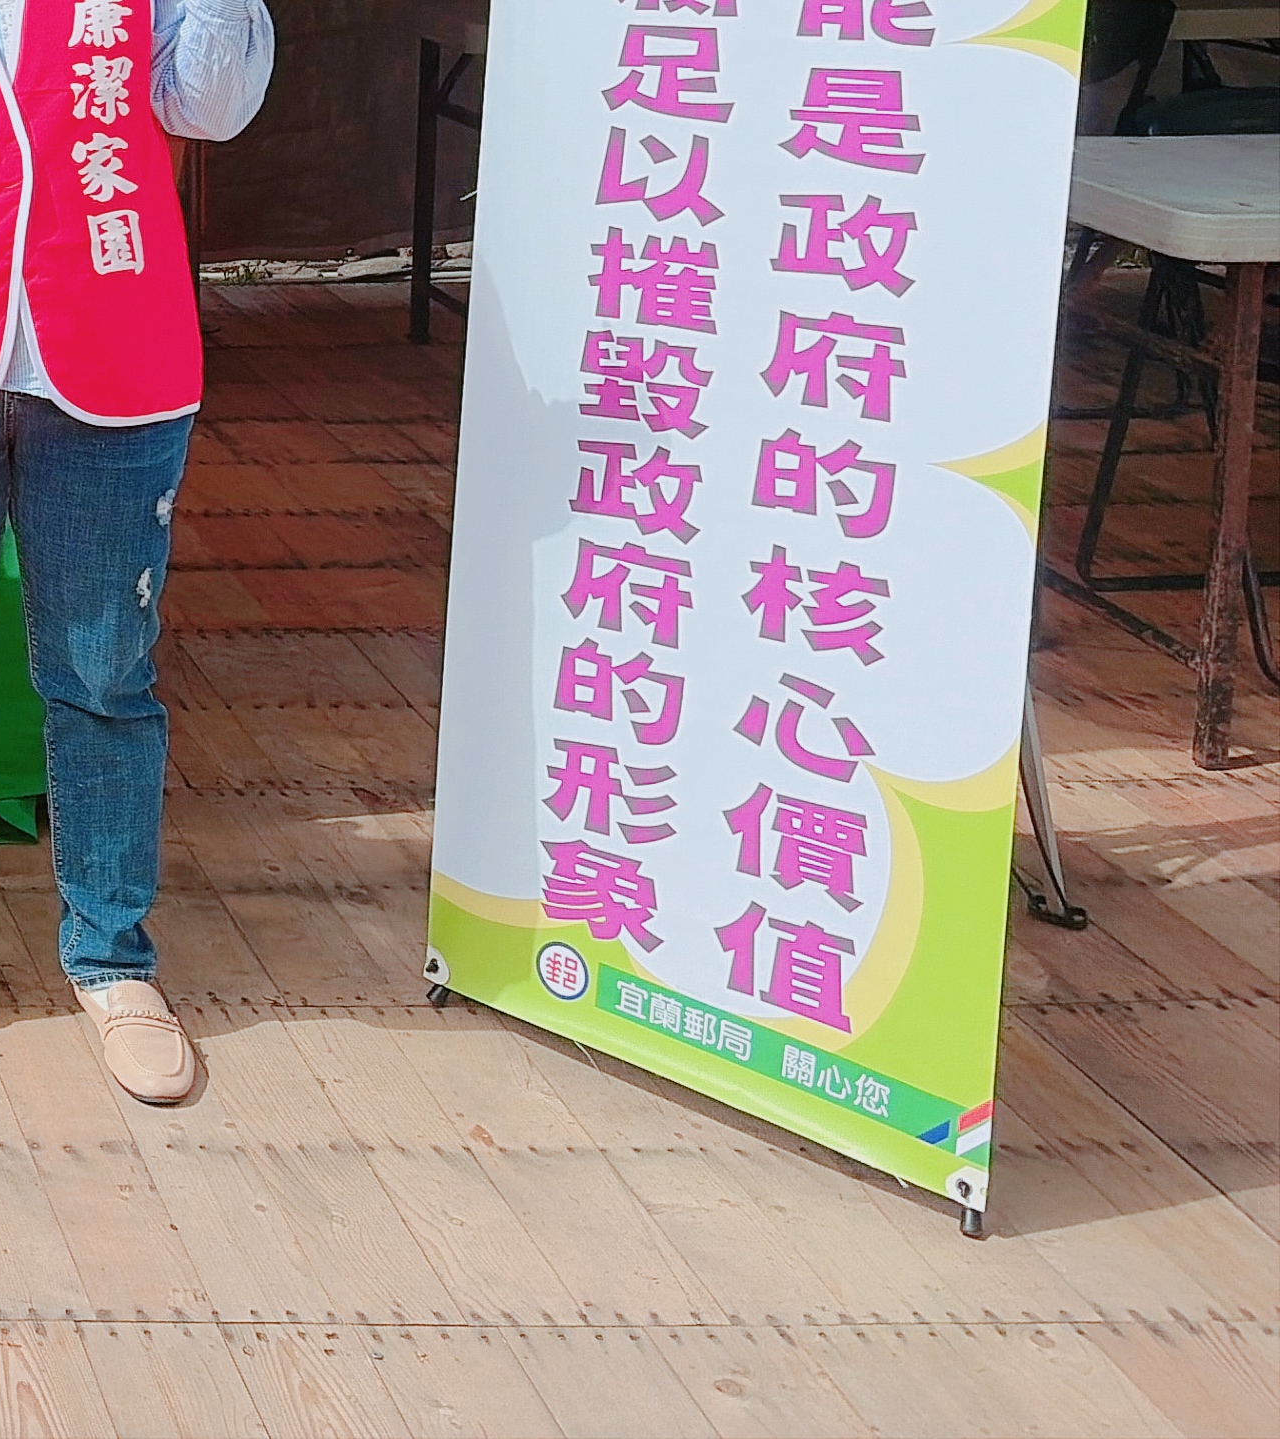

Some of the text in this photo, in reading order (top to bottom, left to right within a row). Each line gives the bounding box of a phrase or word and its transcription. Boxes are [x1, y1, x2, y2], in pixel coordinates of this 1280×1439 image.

[614, 980, 754, 1062] 宜蘭郵局
[781, 1044, 892, 1120] 關心您
